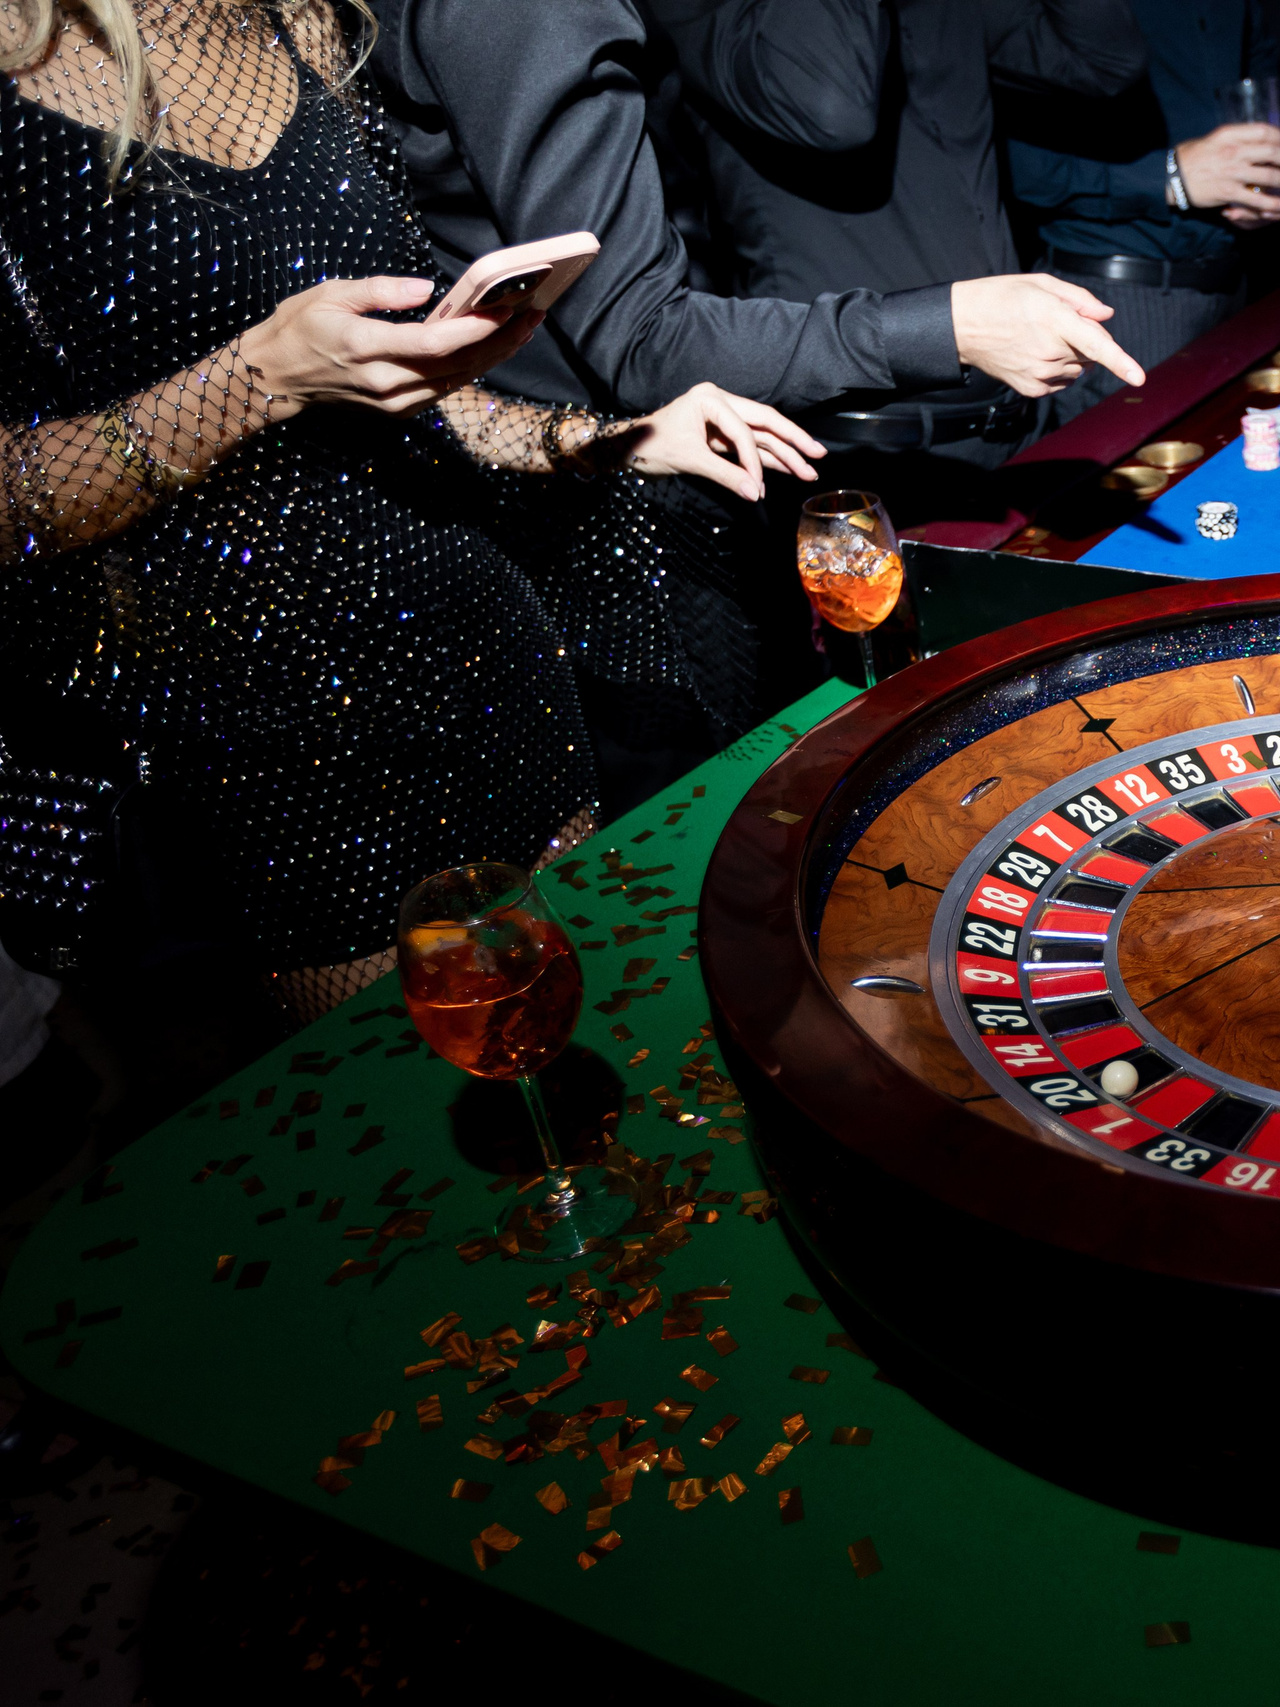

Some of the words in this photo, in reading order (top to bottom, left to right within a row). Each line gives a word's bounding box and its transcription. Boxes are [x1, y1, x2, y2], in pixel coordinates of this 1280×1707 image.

[1158, 754, 1207, 791] 35
[1221, 744, 1247, 773] 3
[1113, 773, 1160, 806] 12
[1066, 794, 1118, 832] 28
[1032, 824, 1074, 852] 7
[998, 850, 1052, 888] 29
[978, 887, 1028, 917] 18
[964, 922, 1017, 956] 22
[963, 968, 1016, 986] 9
[971, 1003, 1030, 1028] 31
[994, 1042, 1054, 1068] 14
[1030, 1078, 1098, 1108] 20
[1091, 1116, 1134, 1135] 1
[1145, 1139, 1211, 1171] 33
[1224, 1162, 1279, 1192] 16
